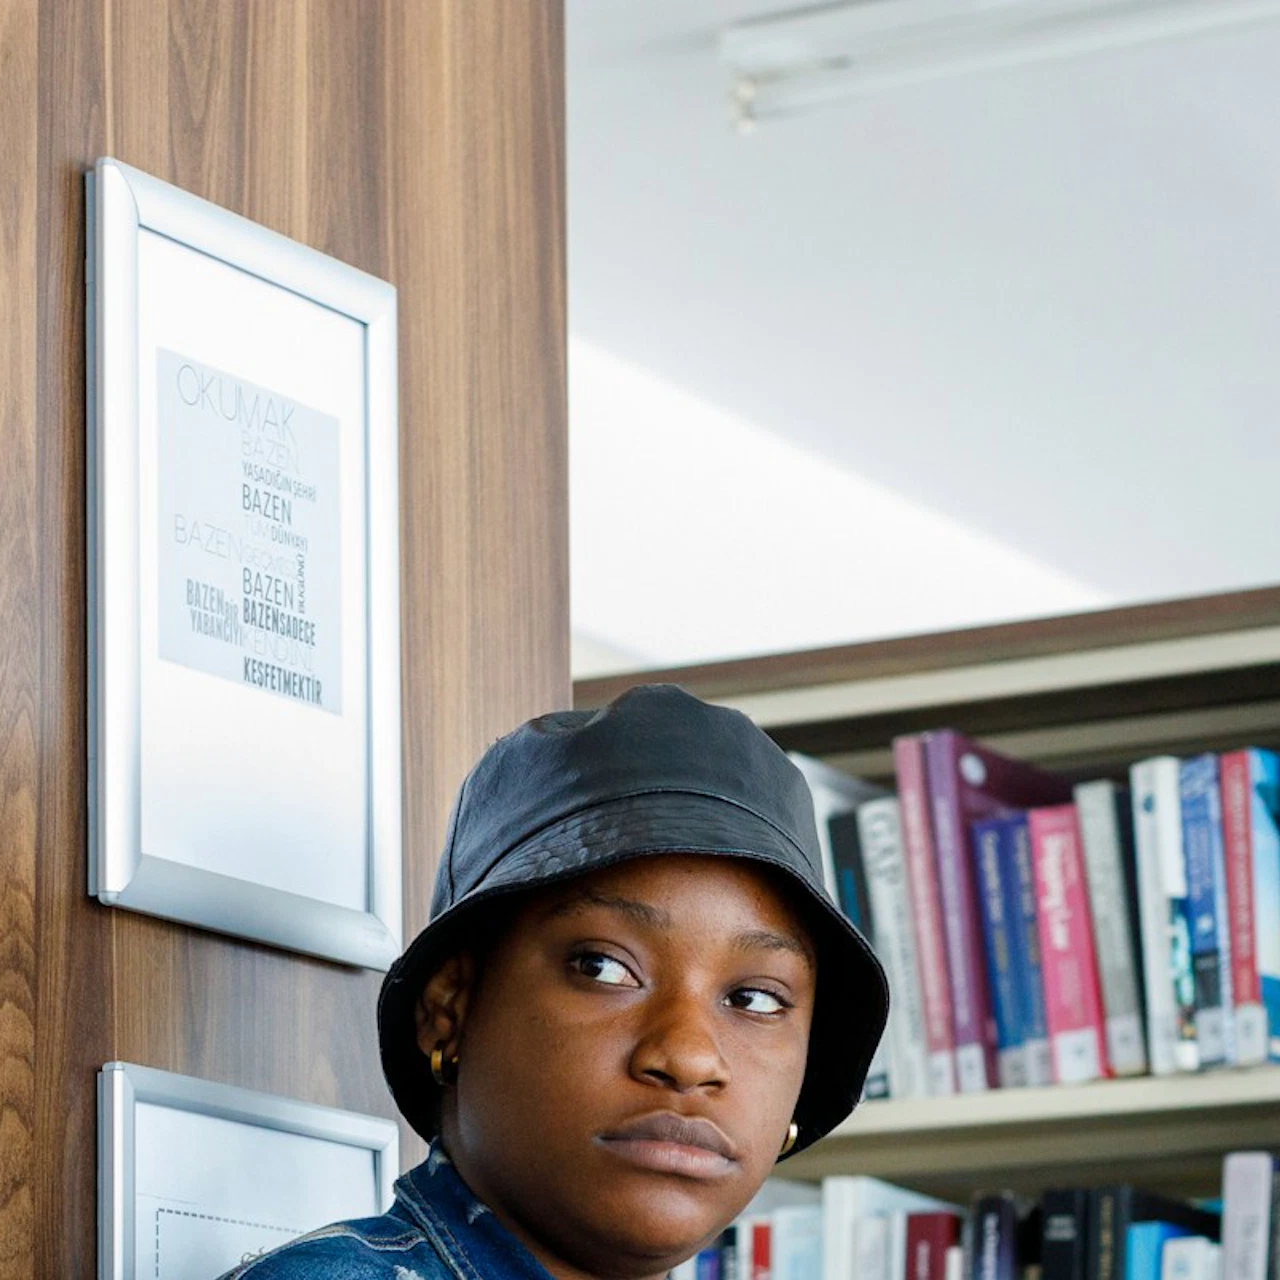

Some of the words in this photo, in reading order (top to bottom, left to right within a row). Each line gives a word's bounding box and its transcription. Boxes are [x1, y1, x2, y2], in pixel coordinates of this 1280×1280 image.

[177, 364, 296, 445] OKUMAK
[243, 483, 291, 526] BAZEN
[174, 514, 244, 564] BAZEN
[187, 578, 224, 616] BAZEN
[243, 567, 294, 610] BAZEN
[243, 598, 279, 635] BAZEN
[244, 655, 322, 706] KEŞFETMEKTİR
